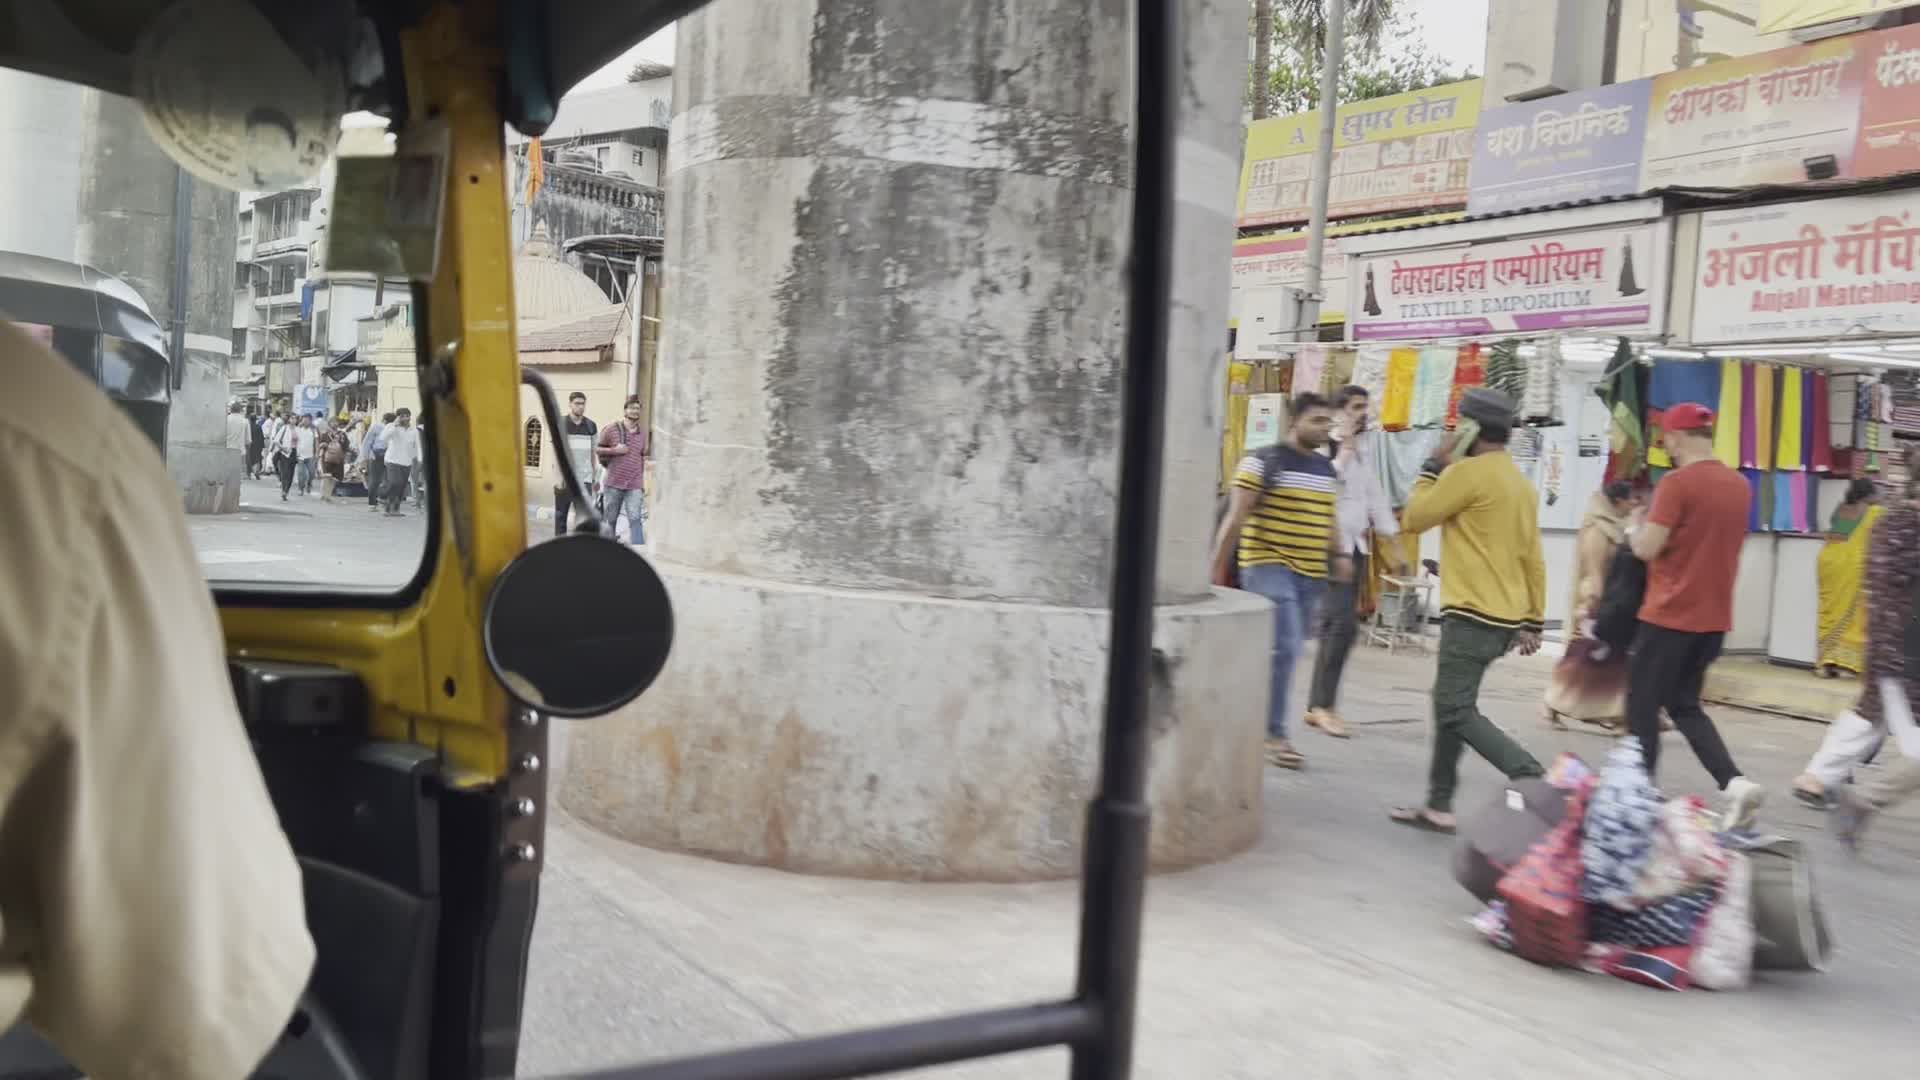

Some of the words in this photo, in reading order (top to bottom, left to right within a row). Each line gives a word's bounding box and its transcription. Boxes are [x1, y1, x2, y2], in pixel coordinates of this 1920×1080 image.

[1342, 108, 1398, 141] सुपर
[1404, 95, 1457, 126] सेल
[1665, 75, 1750, 125] आपका
[1493, 242, 1606, 286] एम्पोरियम
[1703, 222, 1825, 288] अंजली
[1832, 209, 1920, 276] मॅचिं
[1399, 299, 1473, 318] TEXTILE
[1480, 290, 1593, 314] EMPORIUM
[1751, 288, 1811, 313] Anjali
